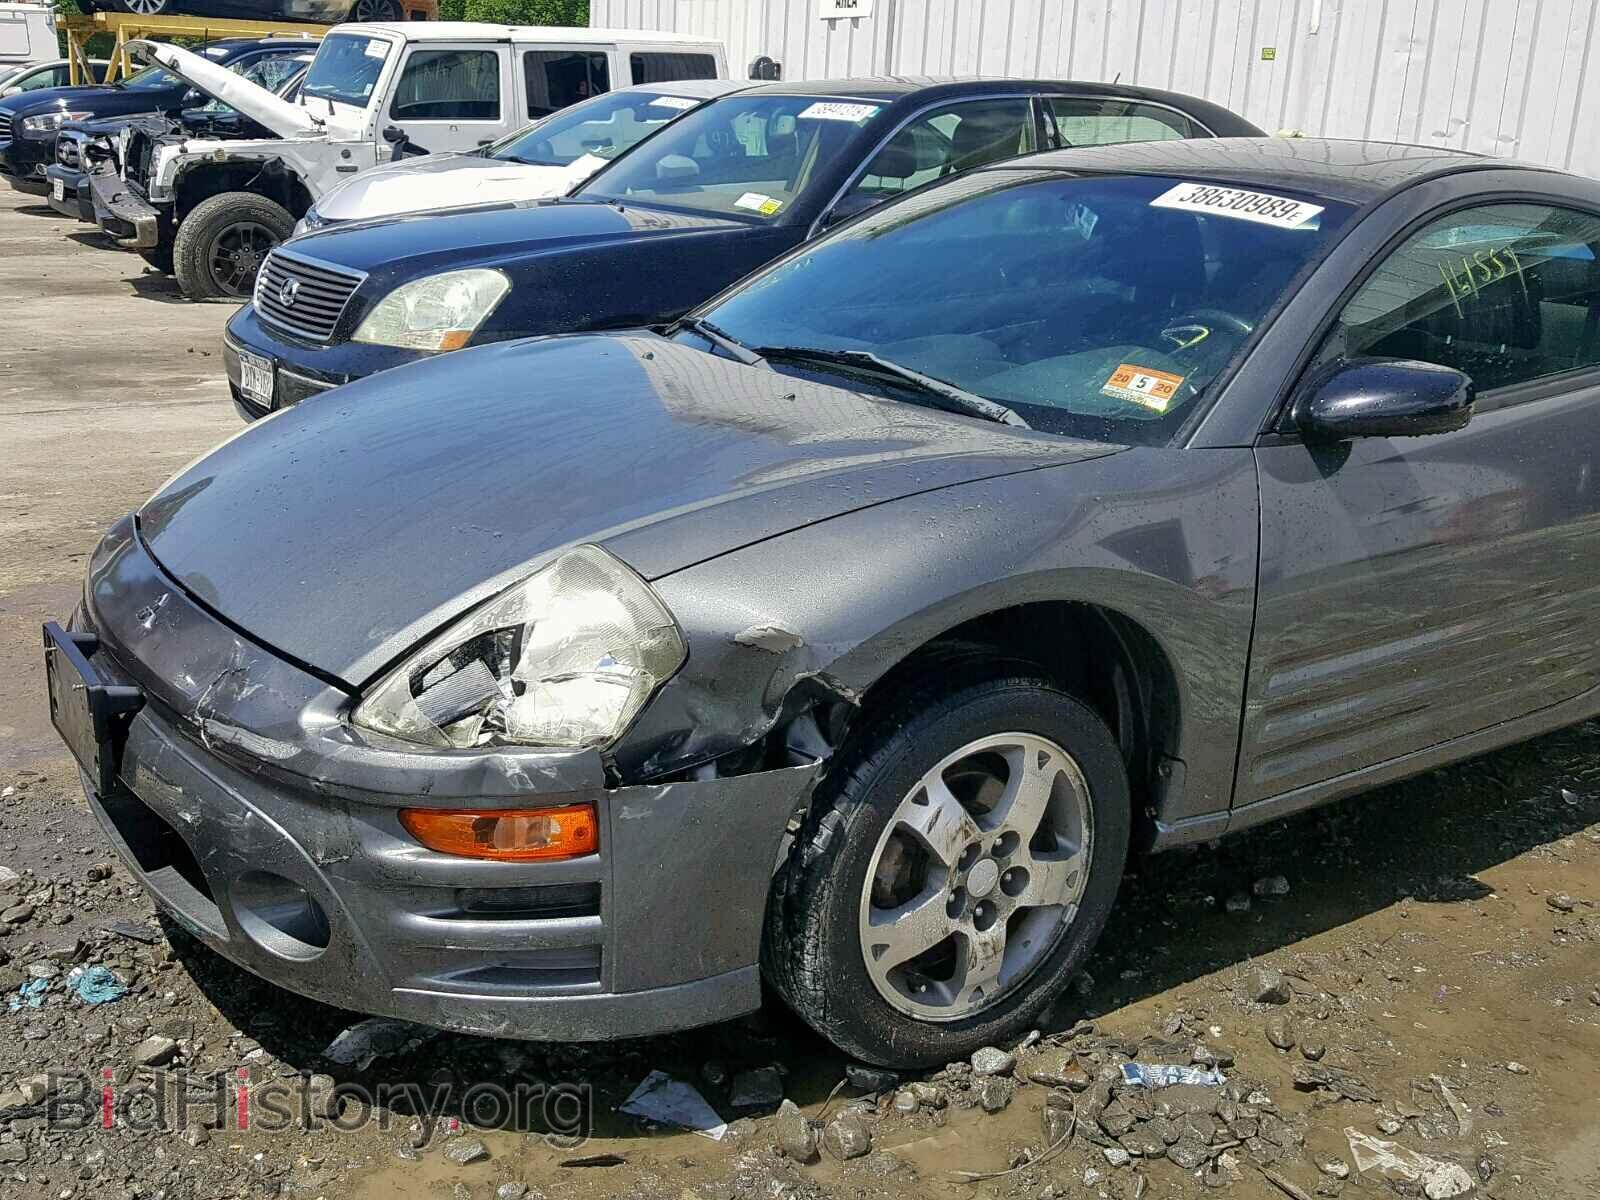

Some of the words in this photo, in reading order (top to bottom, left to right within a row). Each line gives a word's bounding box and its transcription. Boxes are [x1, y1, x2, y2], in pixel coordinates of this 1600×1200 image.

[1113, 373, 1130, 383] 20
[1136, 376, 1150, 389] 5
[1154, 383, 1173, 394] 20
